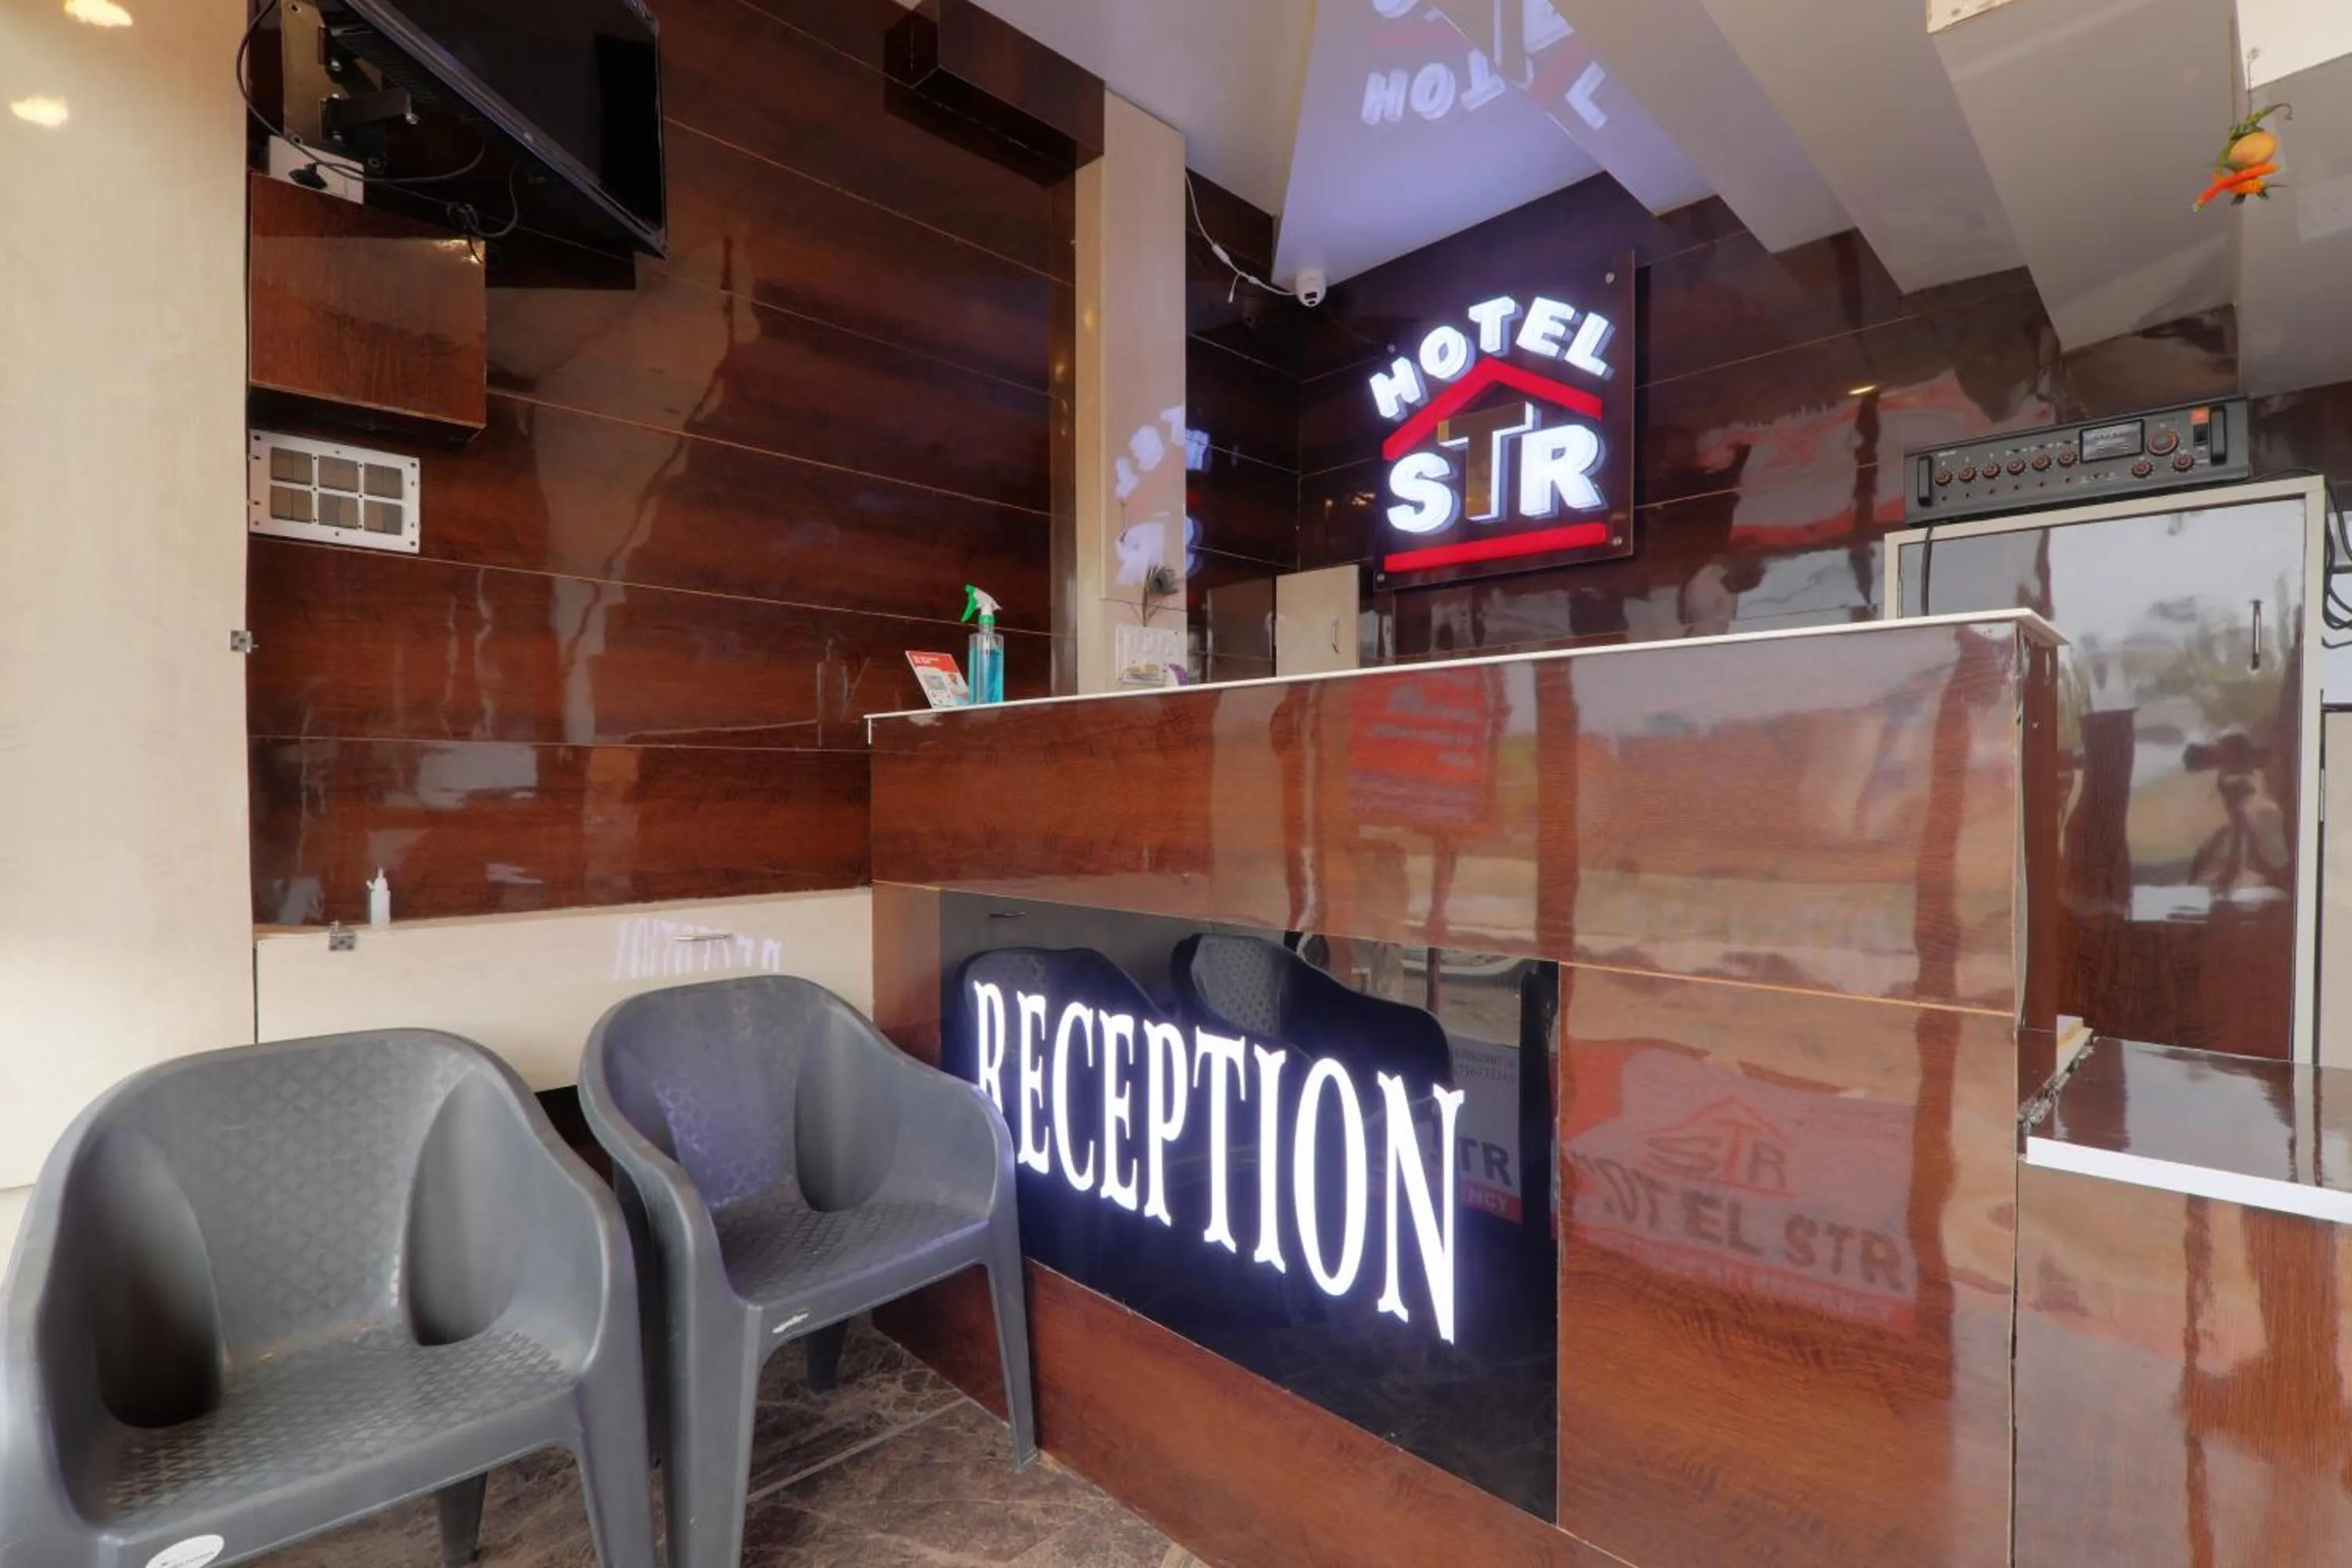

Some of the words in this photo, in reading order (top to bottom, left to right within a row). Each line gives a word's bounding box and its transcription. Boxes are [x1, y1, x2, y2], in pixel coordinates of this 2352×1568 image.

[1369, 296, 1613, 418] HOTEL
[1386, 401, 1606, 533] STR
[973, 981, 1465, 1344] RECEPTION
